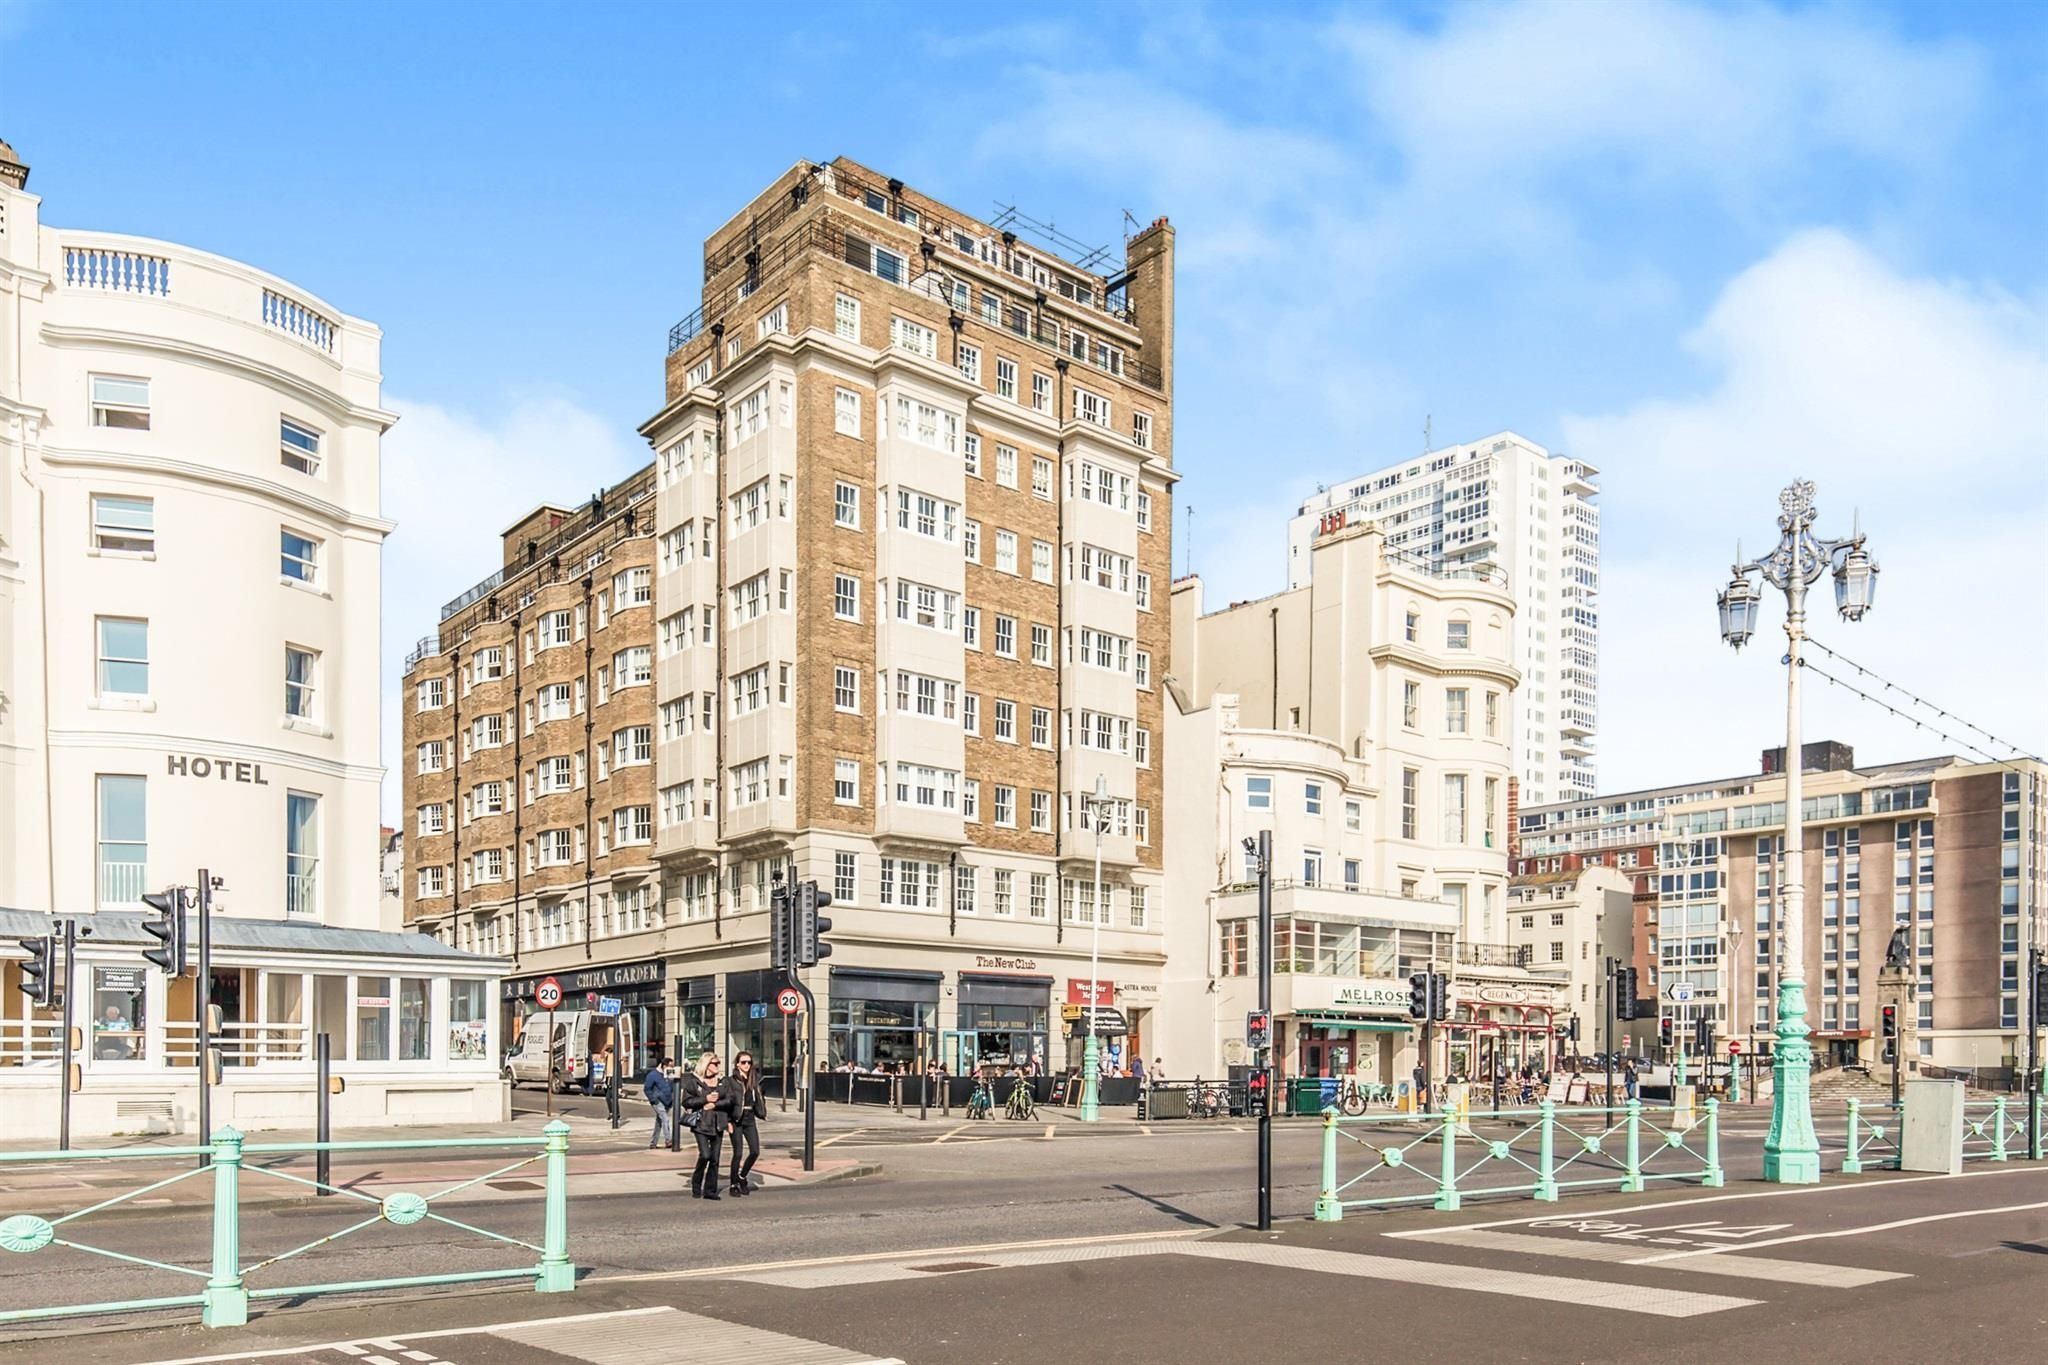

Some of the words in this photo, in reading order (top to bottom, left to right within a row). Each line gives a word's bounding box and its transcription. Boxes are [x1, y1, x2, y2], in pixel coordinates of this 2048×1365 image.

[168, 755, 269, 785] HOTEL
[976, 956, 994, 968] The
[995, 957, 1015, 969] New
[1015, 958, 1037, 970] Club
[577, 974, 608, 988] CHINA
[614, 965, 658, 984] GARDEN
[540, 989, 558, 1000] 20
[1082, 992, 1100, 1000] Nes
[1340, 988, 1412, 1002] MELROSE
[1487, 991, 1519, 999] REGENCY
[782, 996, 797, 1006] 20
